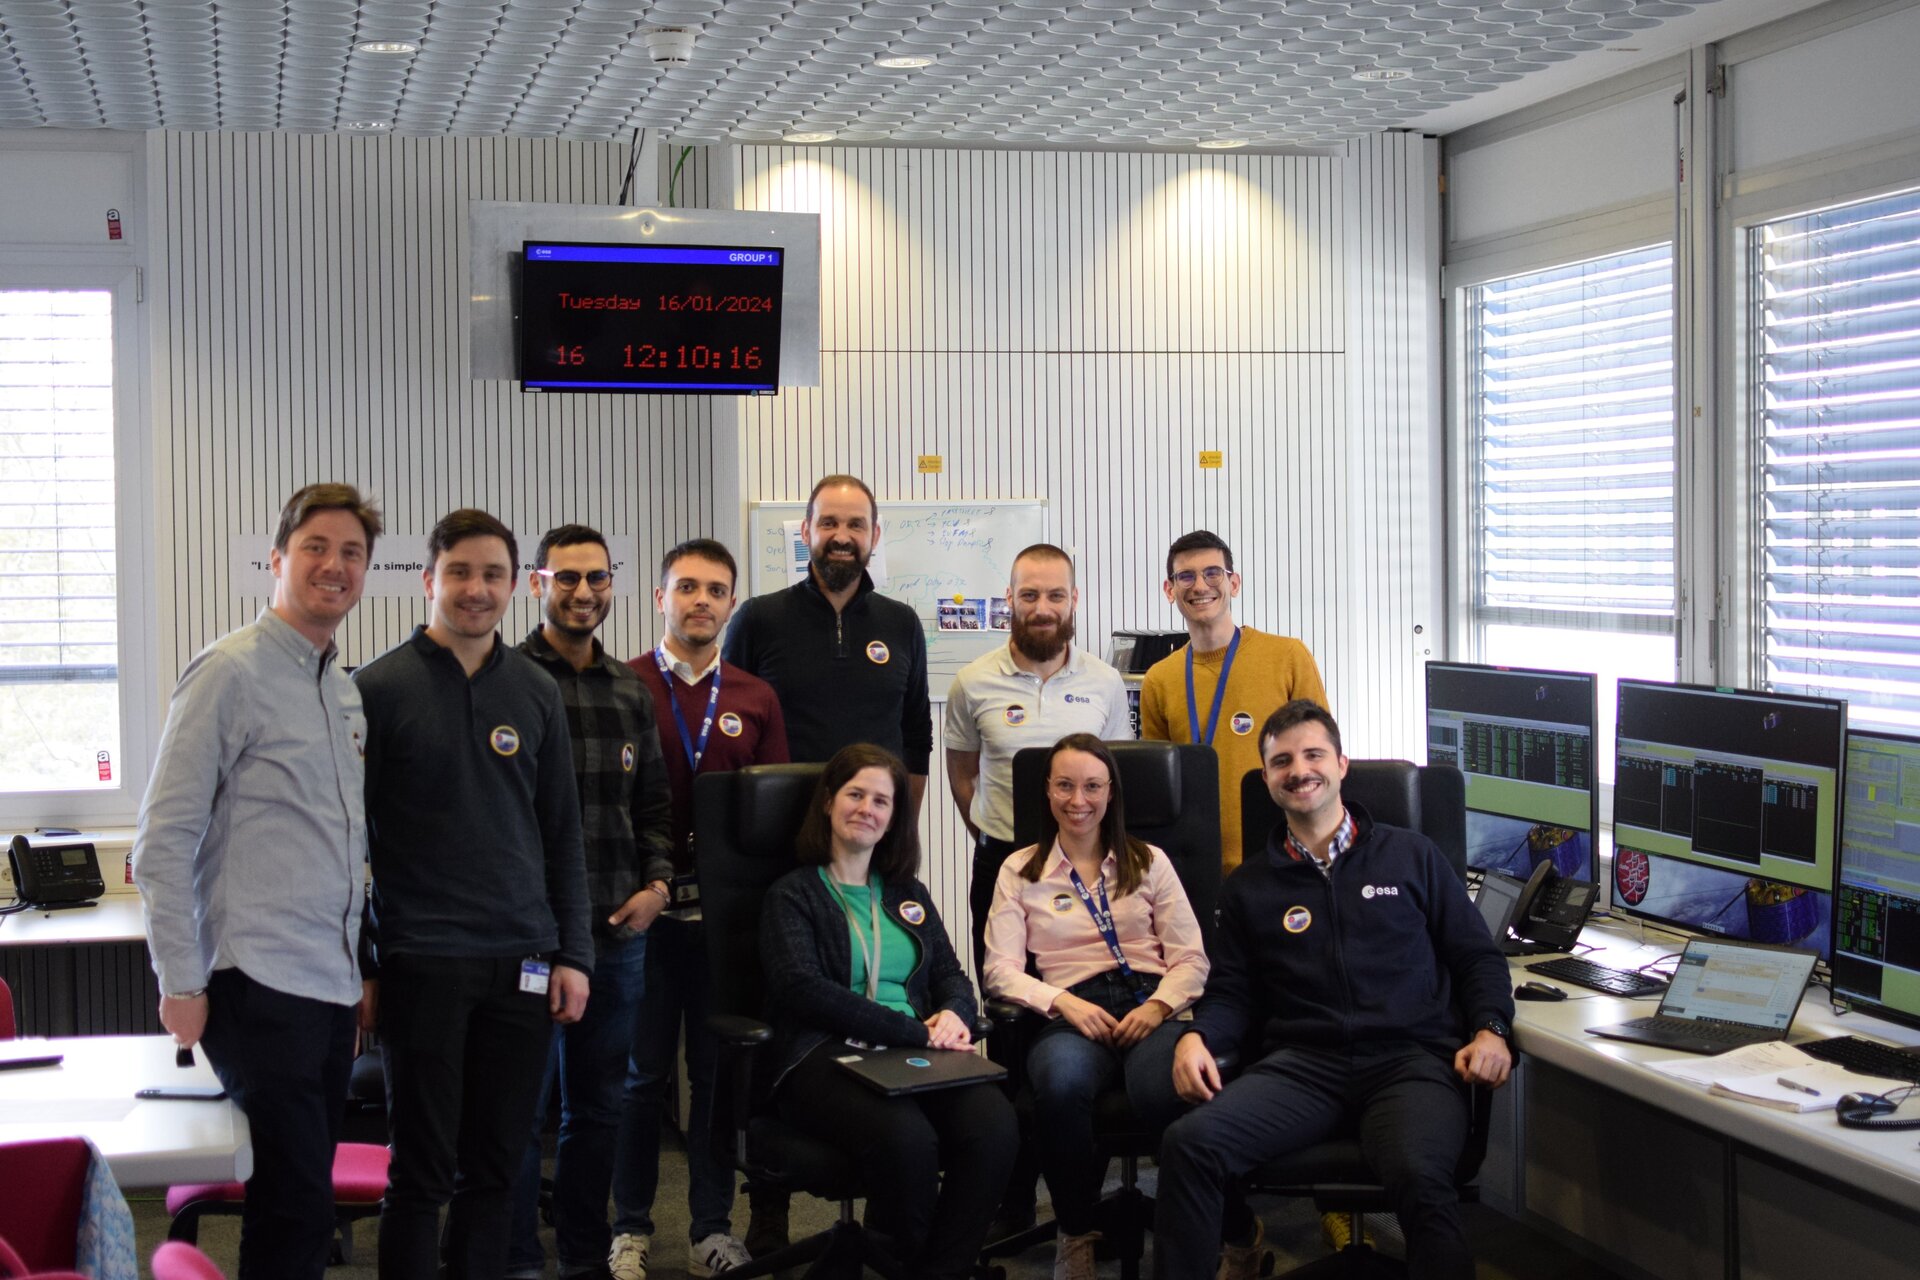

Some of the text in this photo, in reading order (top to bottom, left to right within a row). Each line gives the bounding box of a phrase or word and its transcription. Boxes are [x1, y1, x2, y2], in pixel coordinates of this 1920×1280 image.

[729, 252, 773, 263] GROUP 1
[558, 292, 773, 313] Tuesday 16/01/2024
[557, 344, 762, 370] 16 12:10:16
[384, 561, 424, 573] simple
